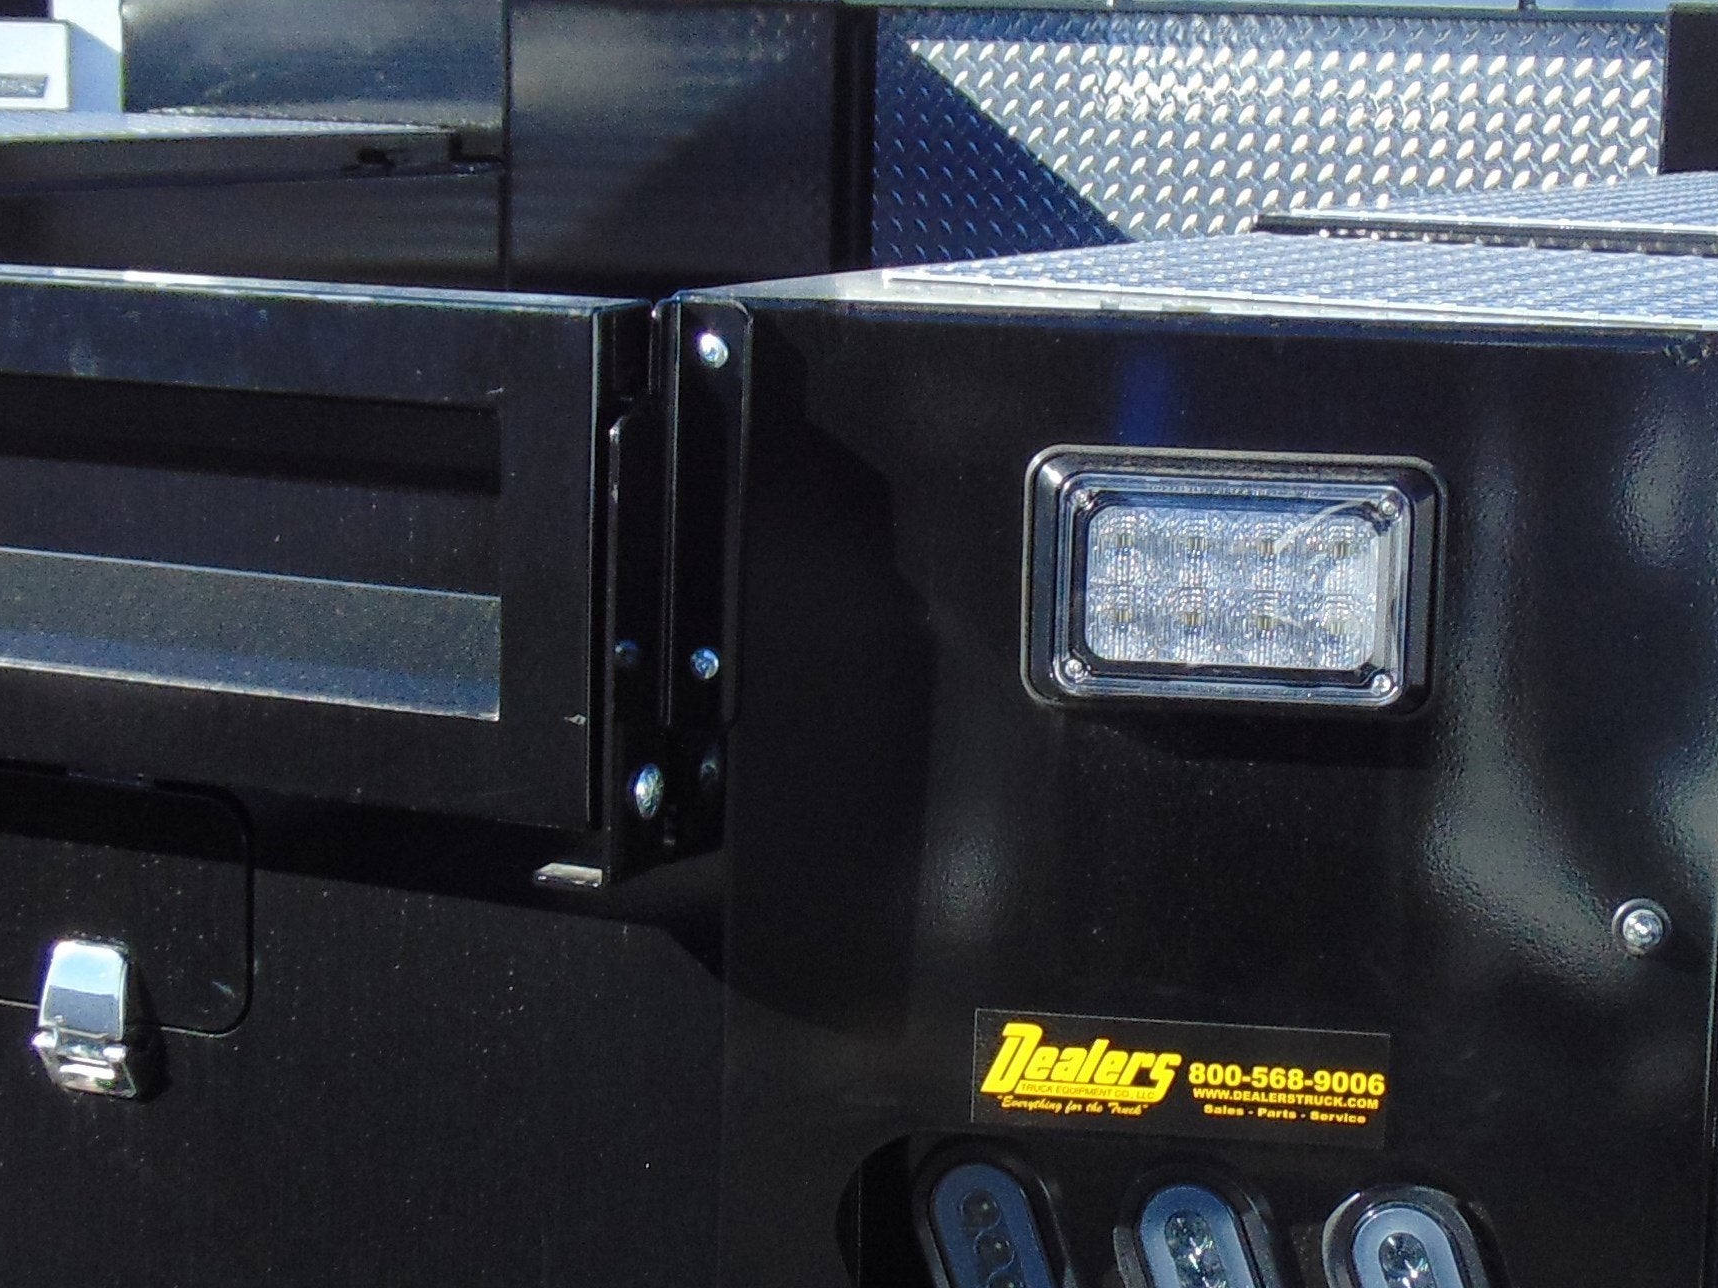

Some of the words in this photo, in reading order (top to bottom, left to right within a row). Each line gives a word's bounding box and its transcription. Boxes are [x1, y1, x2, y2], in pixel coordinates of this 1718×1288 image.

[980, 1022, 1182, 1100] Dealers
[1021, 1083, 1052, 1094] TRUCK
[1056, 1085, 1112, 1097] EQUIPMENT
[1187, 1062, 1386, 1096] 800-568-9006
[1064, 1099, 1083, 1115] for
[1086, 1101, 1103, 1113] the
[1192, 1087, 1379, 1110] WWW.DEALERSTRUCK.COM
[1203, 1103, 1245, 1117] Sales
[1257, 1107, 1297, 1120] Parts
[1310, 1110, 1367, 1124] Service
